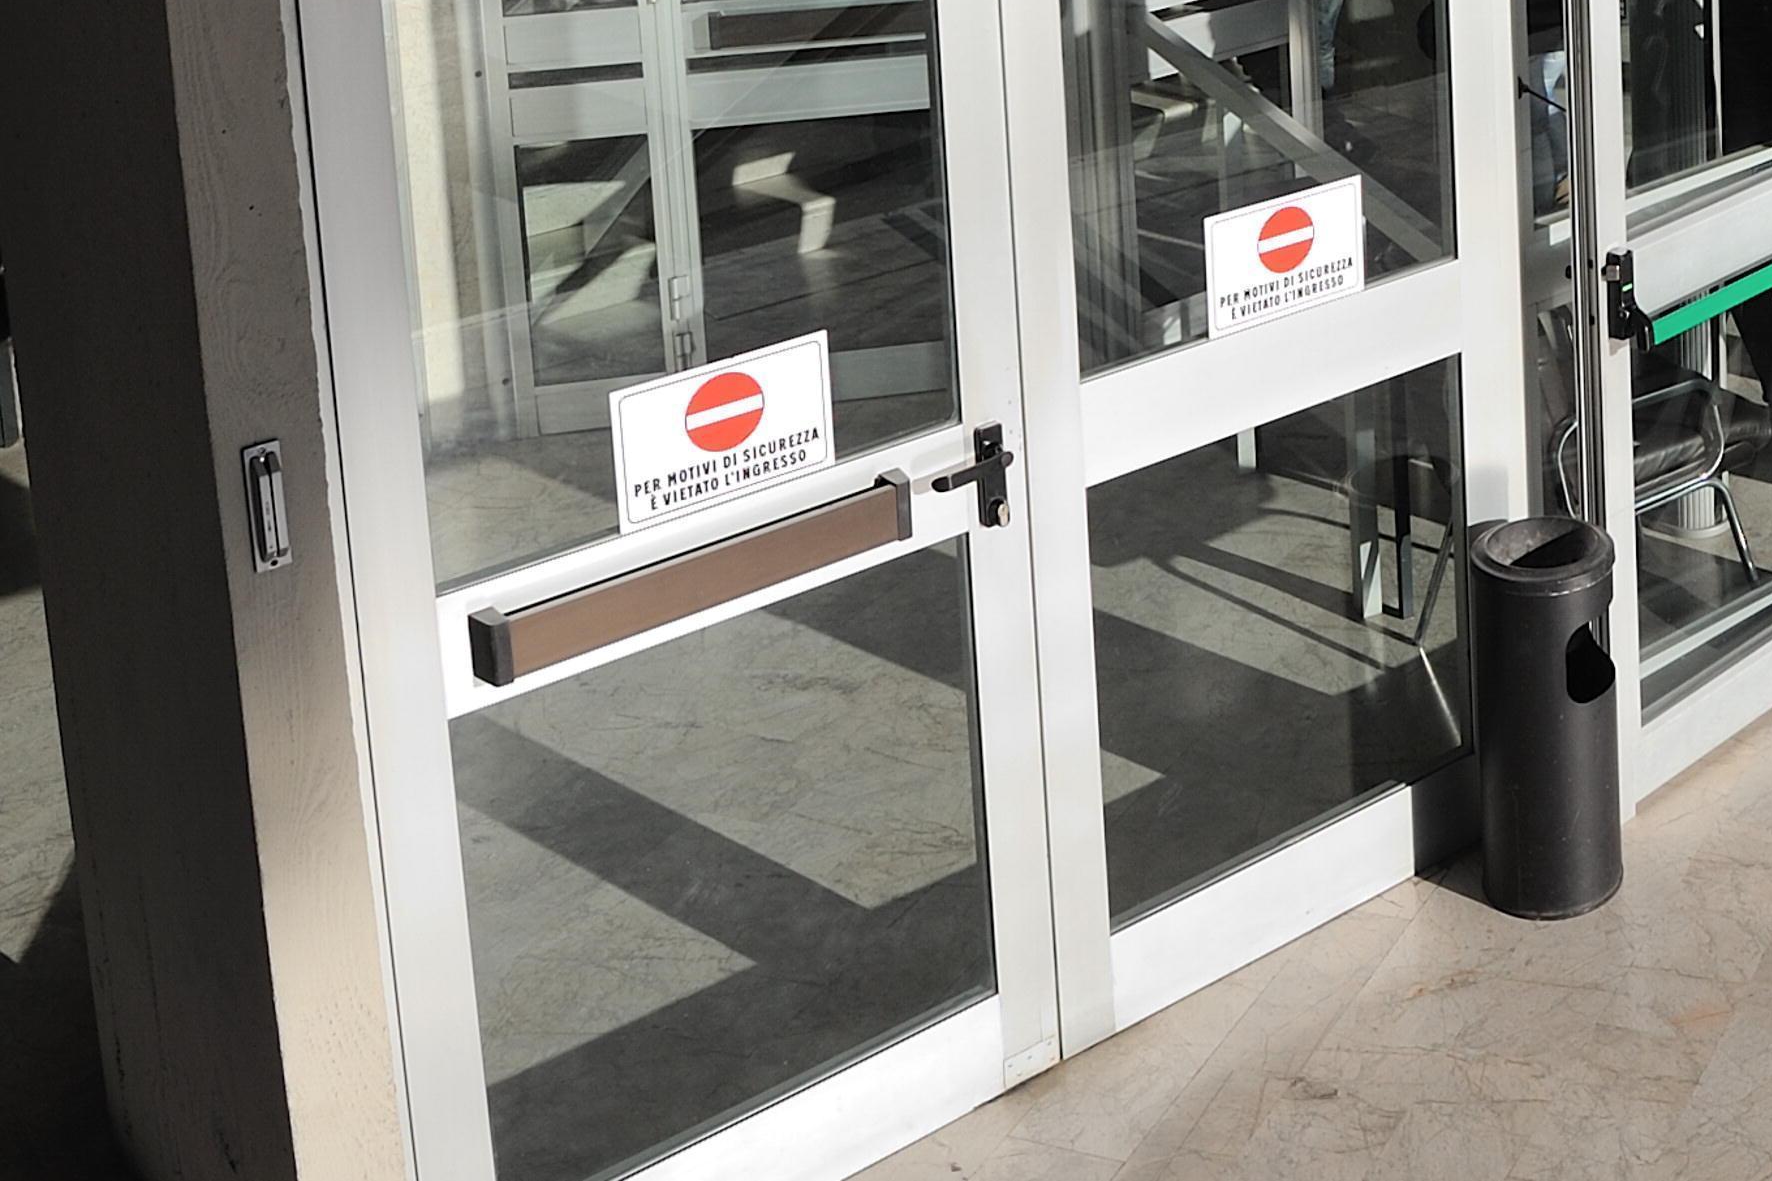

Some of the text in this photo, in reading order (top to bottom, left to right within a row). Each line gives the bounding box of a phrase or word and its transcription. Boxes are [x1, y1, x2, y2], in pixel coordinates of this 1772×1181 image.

[1220, 256, 1353, 309] PER MOTIVI DI SICUREZZA
[1239, 294, 1281, 317] VIETATO
[1284, 274, 1344, 303] L'INGRESSO
[634, 426, 820, 498] PER MOTIVI DI SICUREZZA
[662, 477, 719, 506] VIETATO
[724, 448, 806, 487] L'INGRESSO
